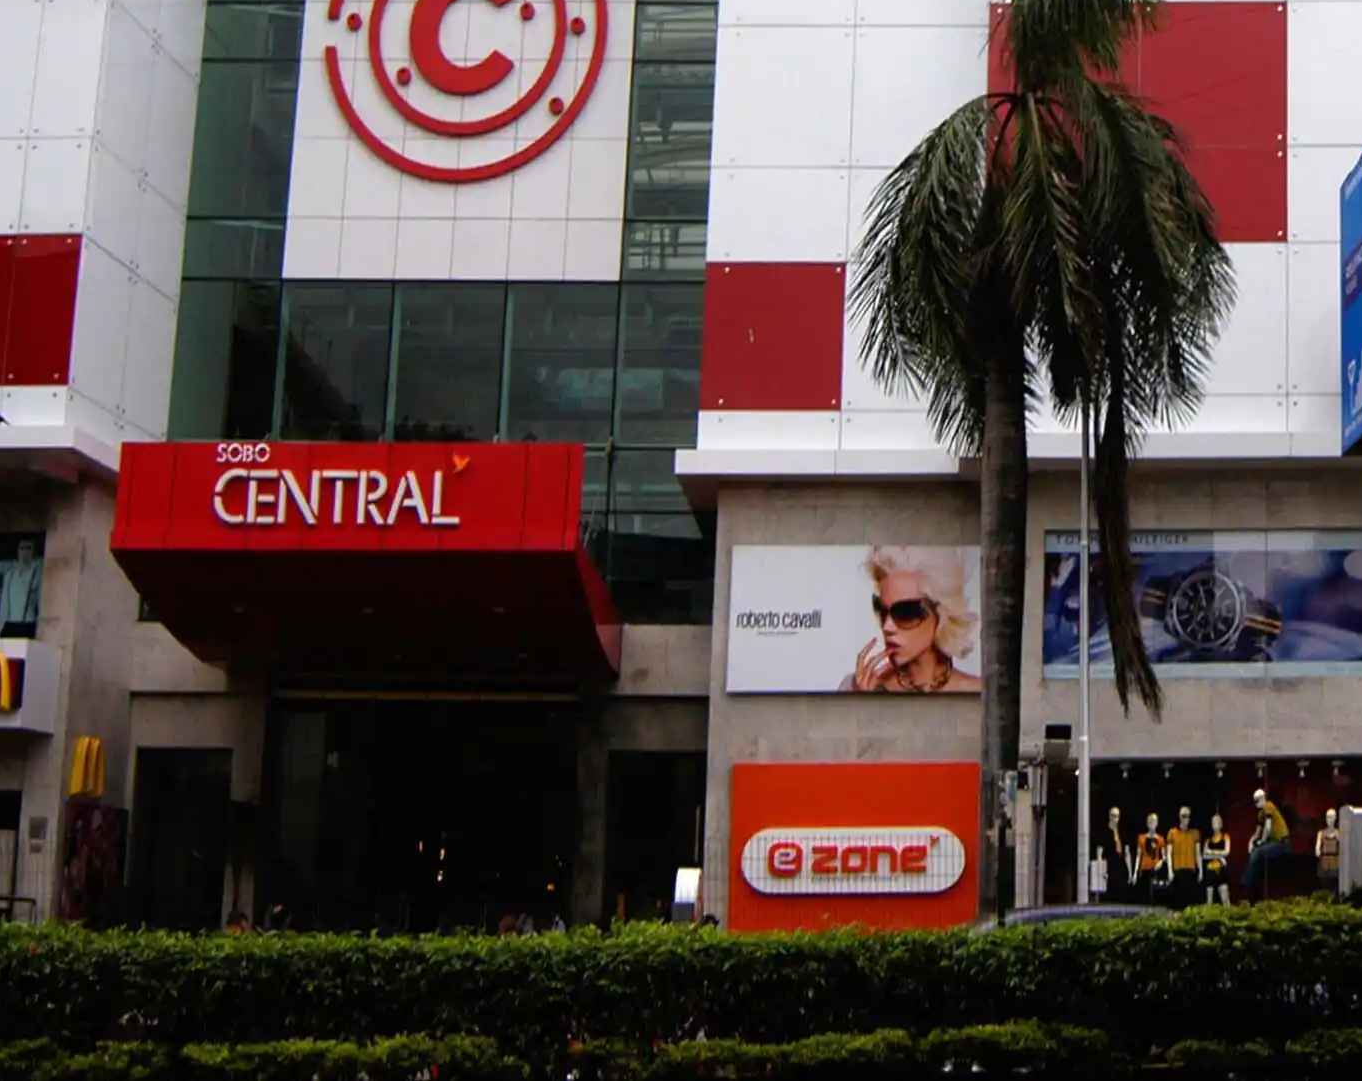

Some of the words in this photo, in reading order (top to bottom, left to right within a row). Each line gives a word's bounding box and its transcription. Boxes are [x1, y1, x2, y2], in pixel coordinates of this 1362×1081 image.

[216, 443, 271, 463] SOBO
[212, 467, 461, 526] CENTRAL
[735, 608, 780, 629] roberto
[782, 608, 823, 629] cavalli
[810, 844, 929, 874] zone
